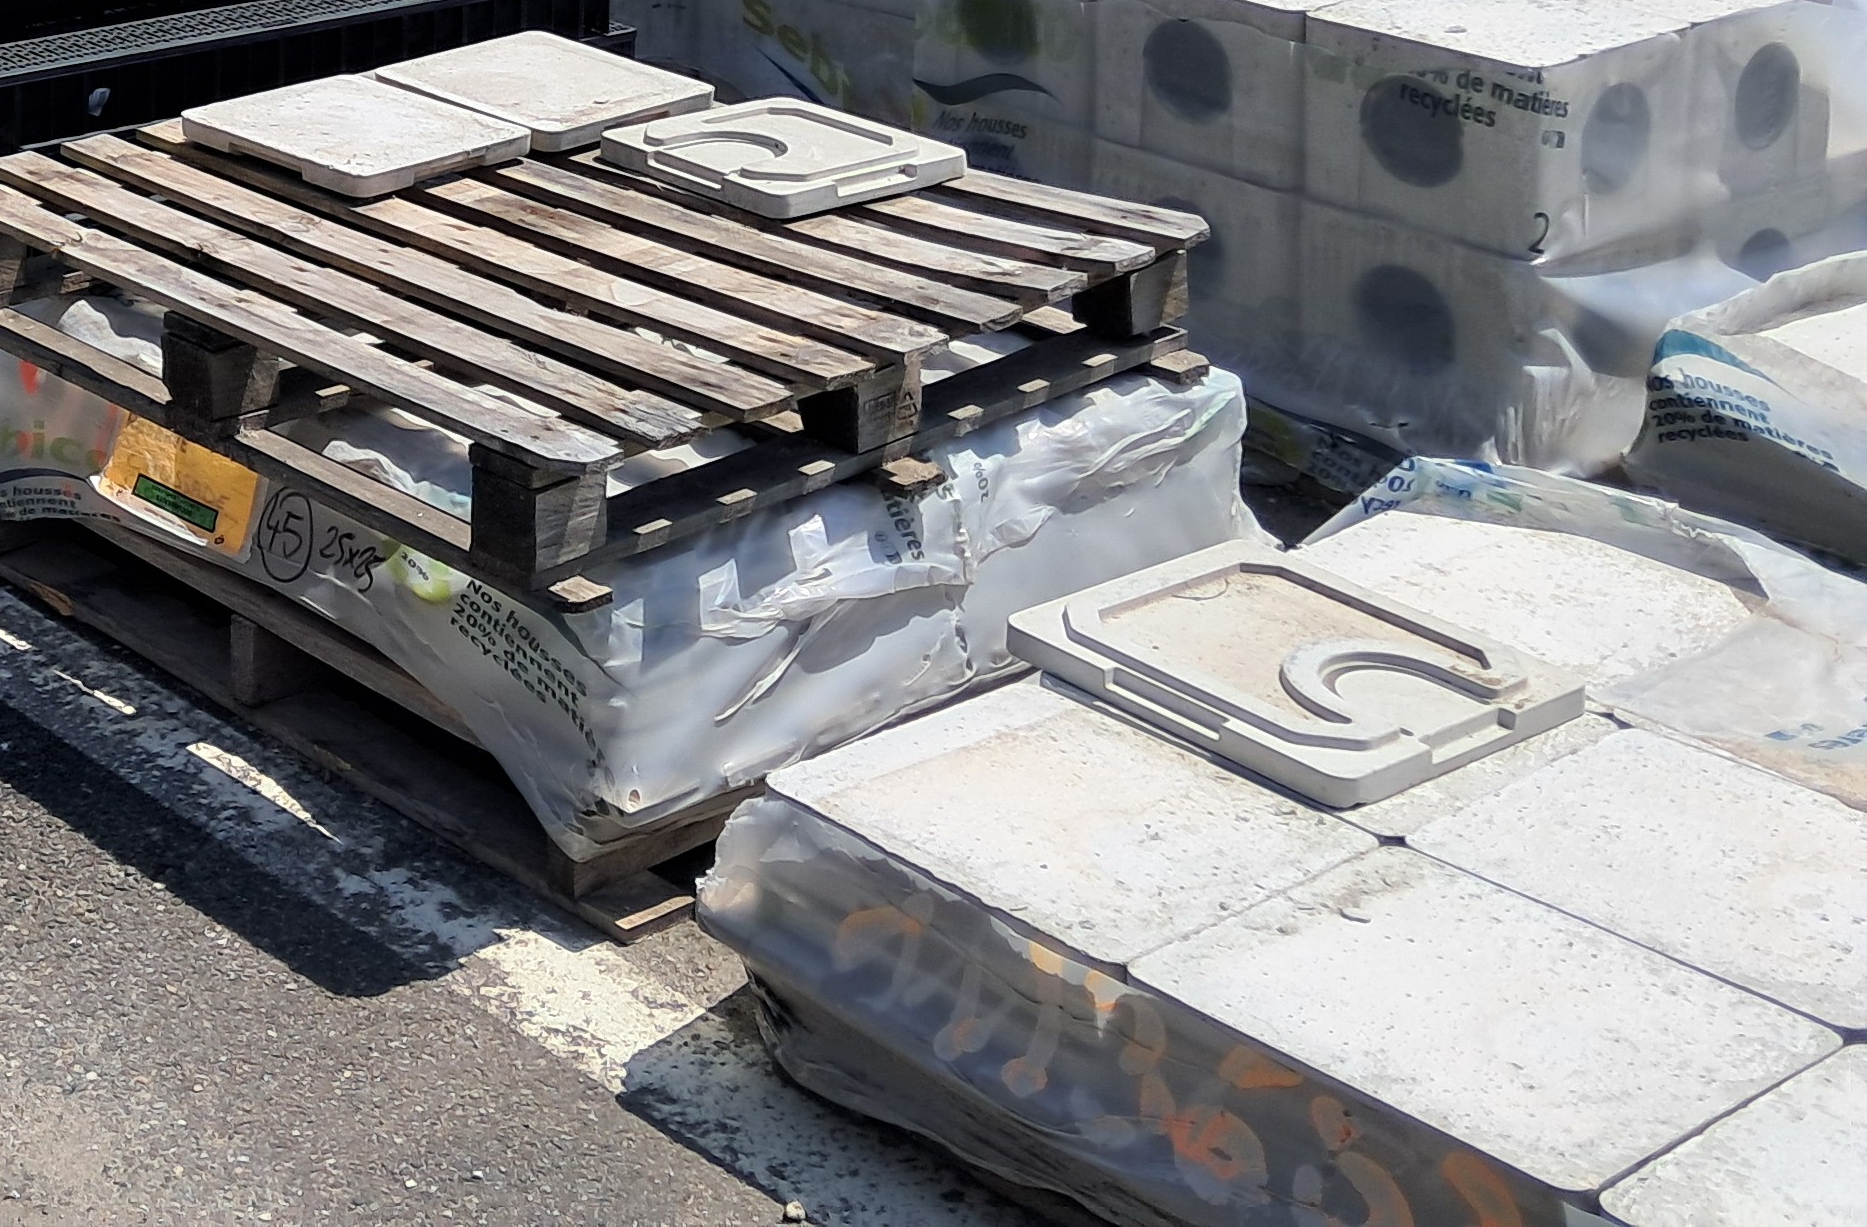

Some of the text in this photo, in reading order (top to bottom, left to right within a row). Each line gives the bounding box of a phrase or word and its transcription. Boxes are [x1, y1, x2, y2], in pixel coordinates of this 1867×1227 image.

[1400, 83, 1497, 127] recyclées
[1456, 70, 1483, 93] de
[1491, 82, 1570, 118] matières
[965, 112, 1028, 139] housses
[1527, 212, 1550, 255] 2
[1649, 391, 1771, 425] contiennent
[1653, 411, 1695, 428] 20%
[1701, 409, 1728, 425] de
[1659, 425, 1749, 443] recyclées
[266, 493, 303, 558] 45
[400, 552, 430, 581] 20%
[449, 615, 547, 704] recyclées
[452, 603, 497, 647] 20%
[503, 644, 530, 675] de
[460, 593, 580, 709] contiennent
[466, 580, 588, 698] Nos housses
